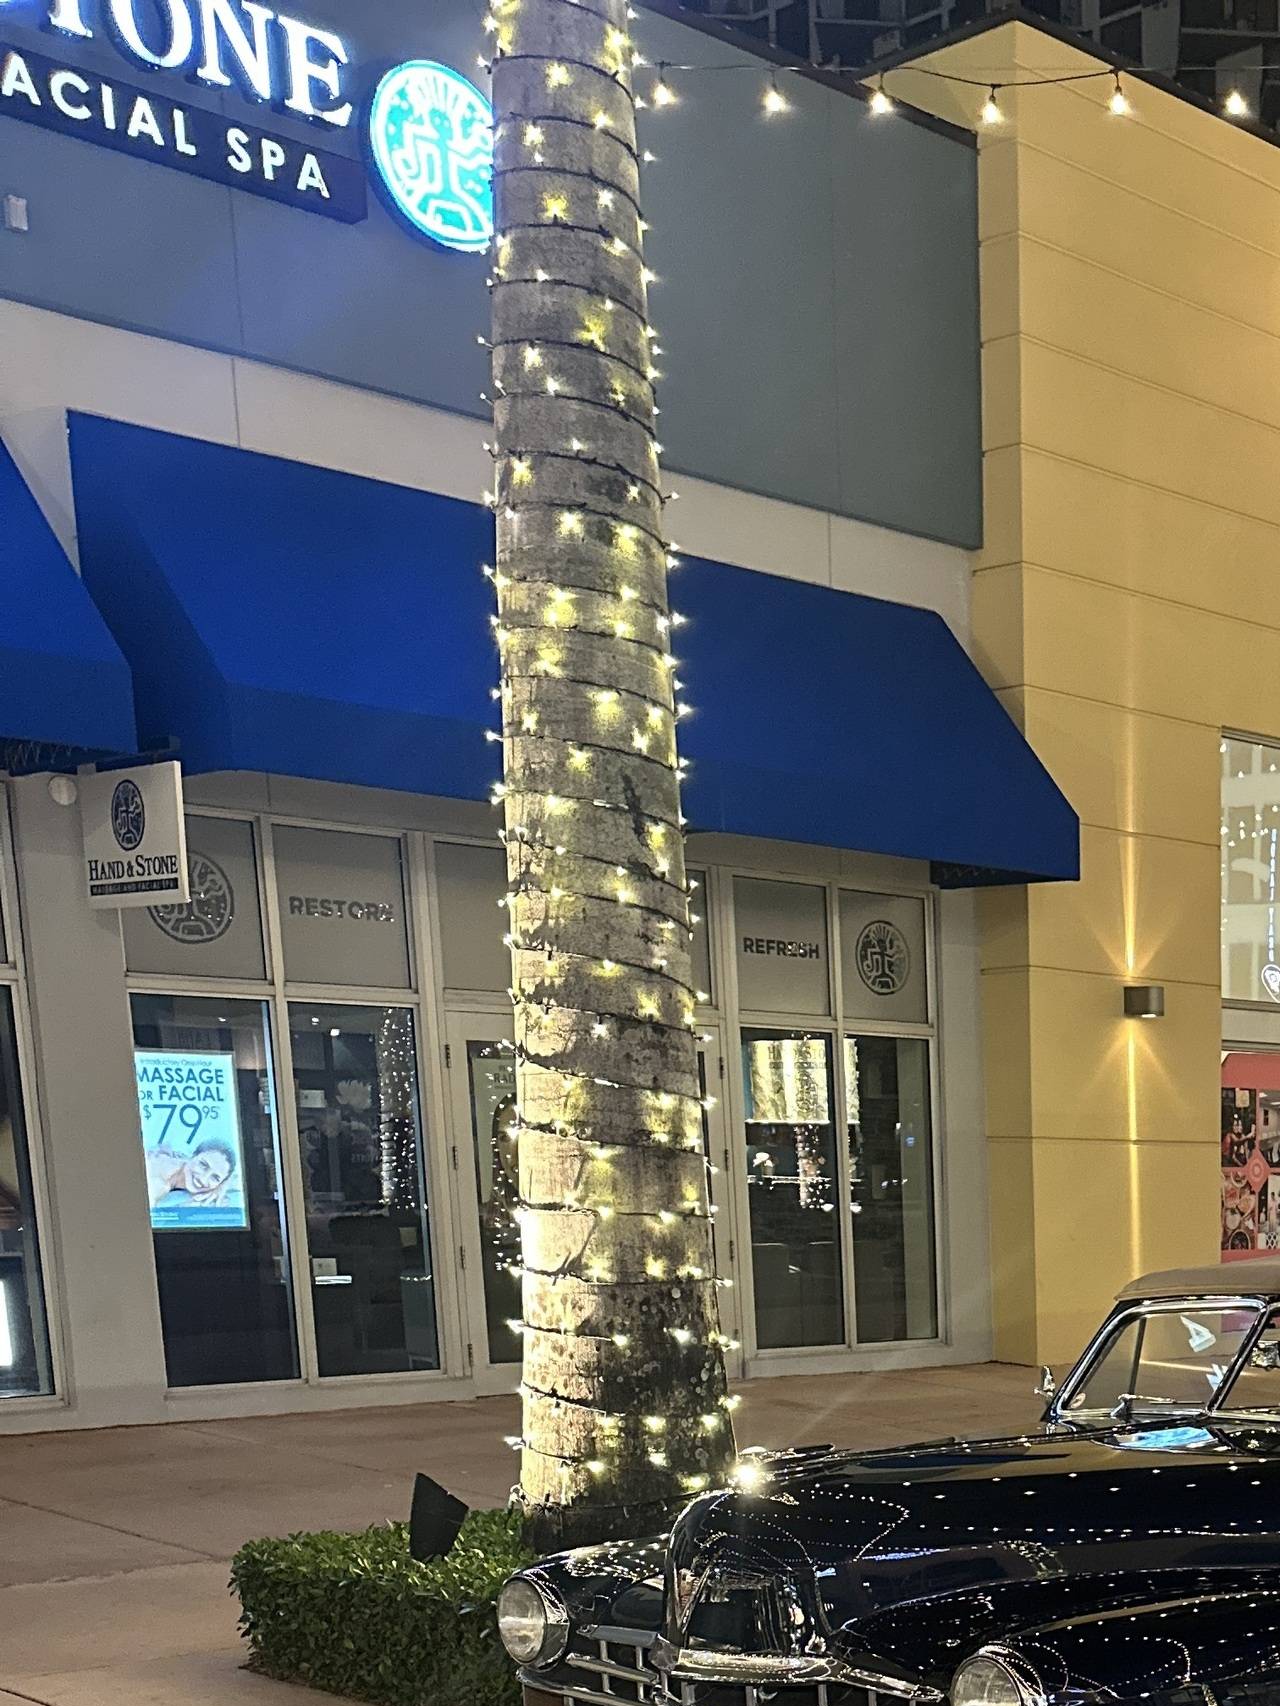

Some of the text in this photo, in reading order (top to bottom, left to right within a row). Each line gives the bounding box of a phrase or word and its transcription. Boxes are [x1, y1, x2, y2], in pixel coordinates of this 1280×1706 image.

[226, 127, 331, 199] SPA
[88, 854, 178, 881] HAND & STONE
[742, 936, 820, 959] REFRESH
[138, 1066, 225, 1085] MASSAGE
[158, 1085, 225, 1102] FACIAL
